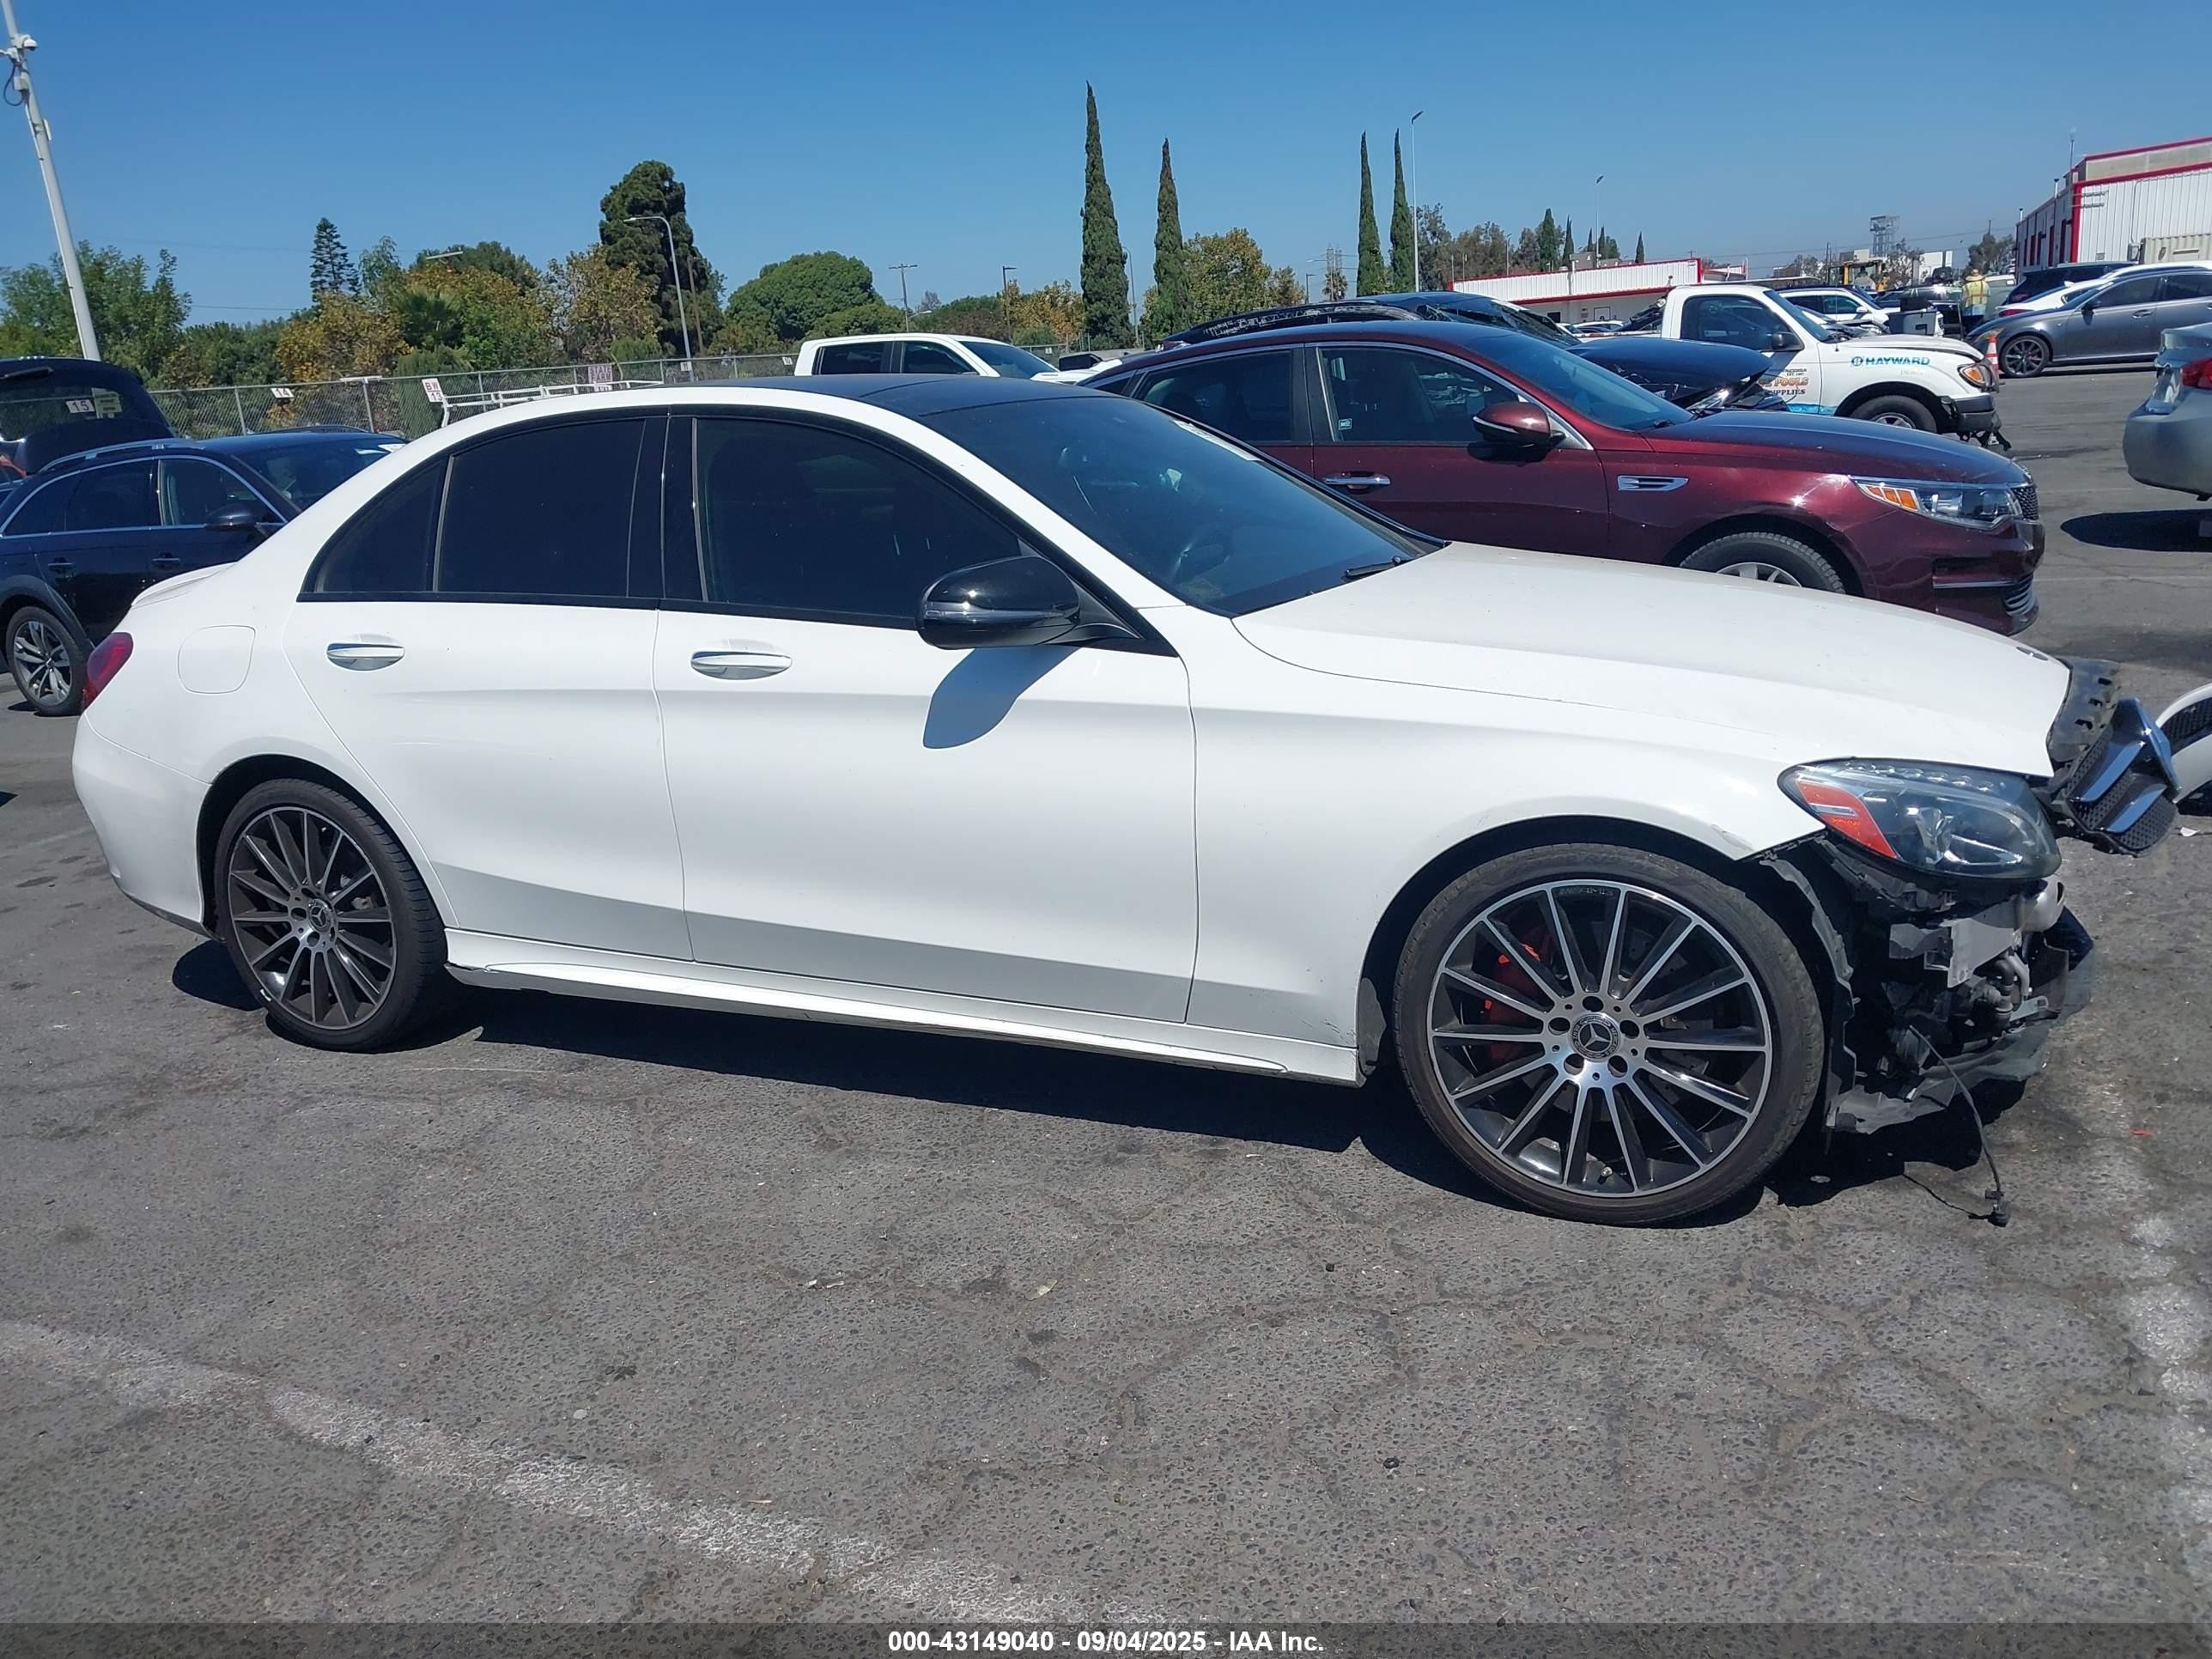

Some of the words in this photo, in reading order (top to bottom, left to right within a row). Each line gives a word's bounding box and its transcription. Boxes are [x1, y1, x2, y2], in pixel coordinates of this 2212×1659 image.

[1863, 356, 1930, 366] HAYWARD
[589, 365, 611, 374] STATE
[1774, 377, 1809, 386] POOLS
[424, 382, 439, 391] BW
[275, 387, 290, 397] 14
[431, 392, 443, 401] 13
[71, 400, 89, 412] 15
